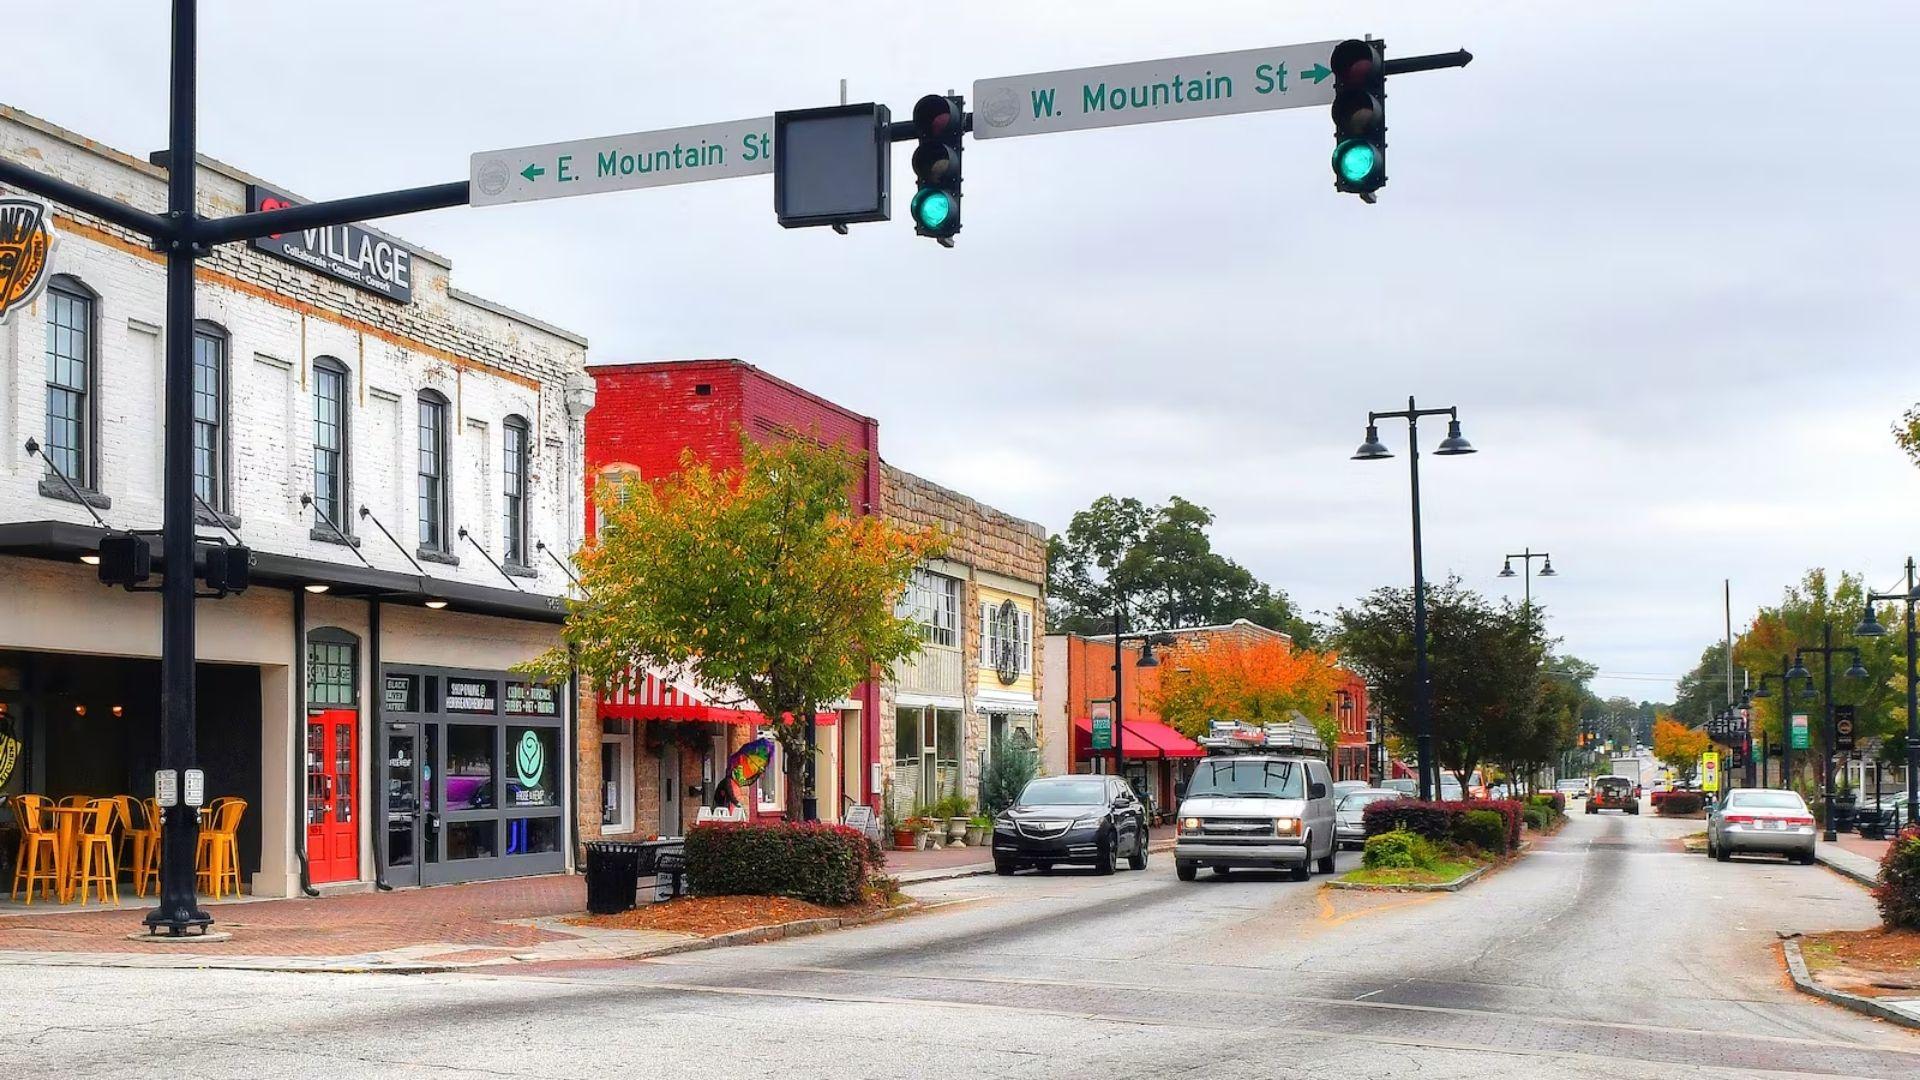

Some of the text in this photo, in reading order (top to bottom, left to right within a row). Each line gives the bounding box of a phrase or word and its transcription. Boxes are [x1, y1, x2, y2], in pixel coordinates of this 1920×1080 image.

[1031, 87, 1062, 118] W.
[1083, 70, 1232, 113] Mountain
[1255, 60, 1288, 94] St
[557, 132, 770, 182] E. Mountain St
[19, 240, 43, 291] KITCHEN
[284, 243, 391, 293] Collaborate Connect Cowork
[303, 225, 409, 288] VILLAGE
[387, 680, 406, 689] BLACK
